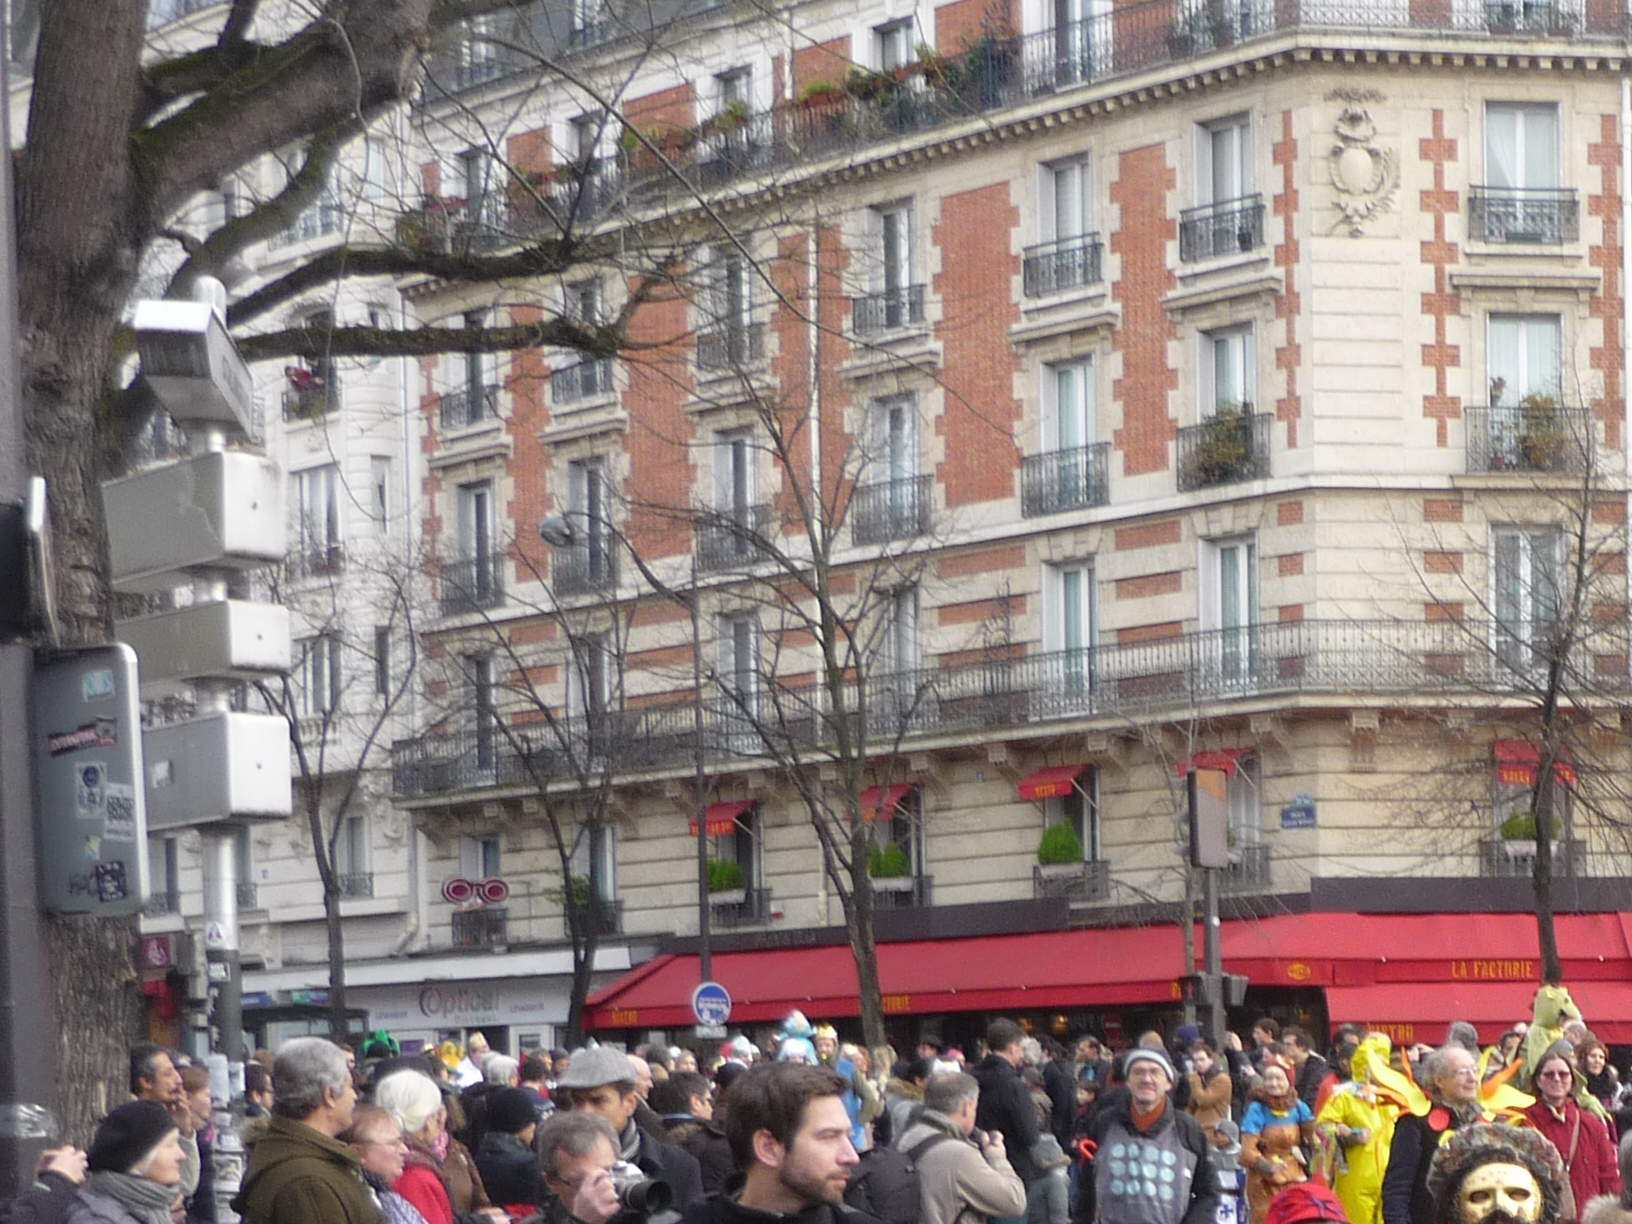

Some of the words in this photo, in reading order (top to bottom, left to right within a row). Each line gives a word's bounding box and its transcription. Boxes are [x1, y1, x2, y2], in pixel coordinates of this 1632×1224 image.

[1451, 961, 1468, 979] LA
[1473, 961, 1534, 979] FACTORIE
[419, 985, 499, 1018] Optical
